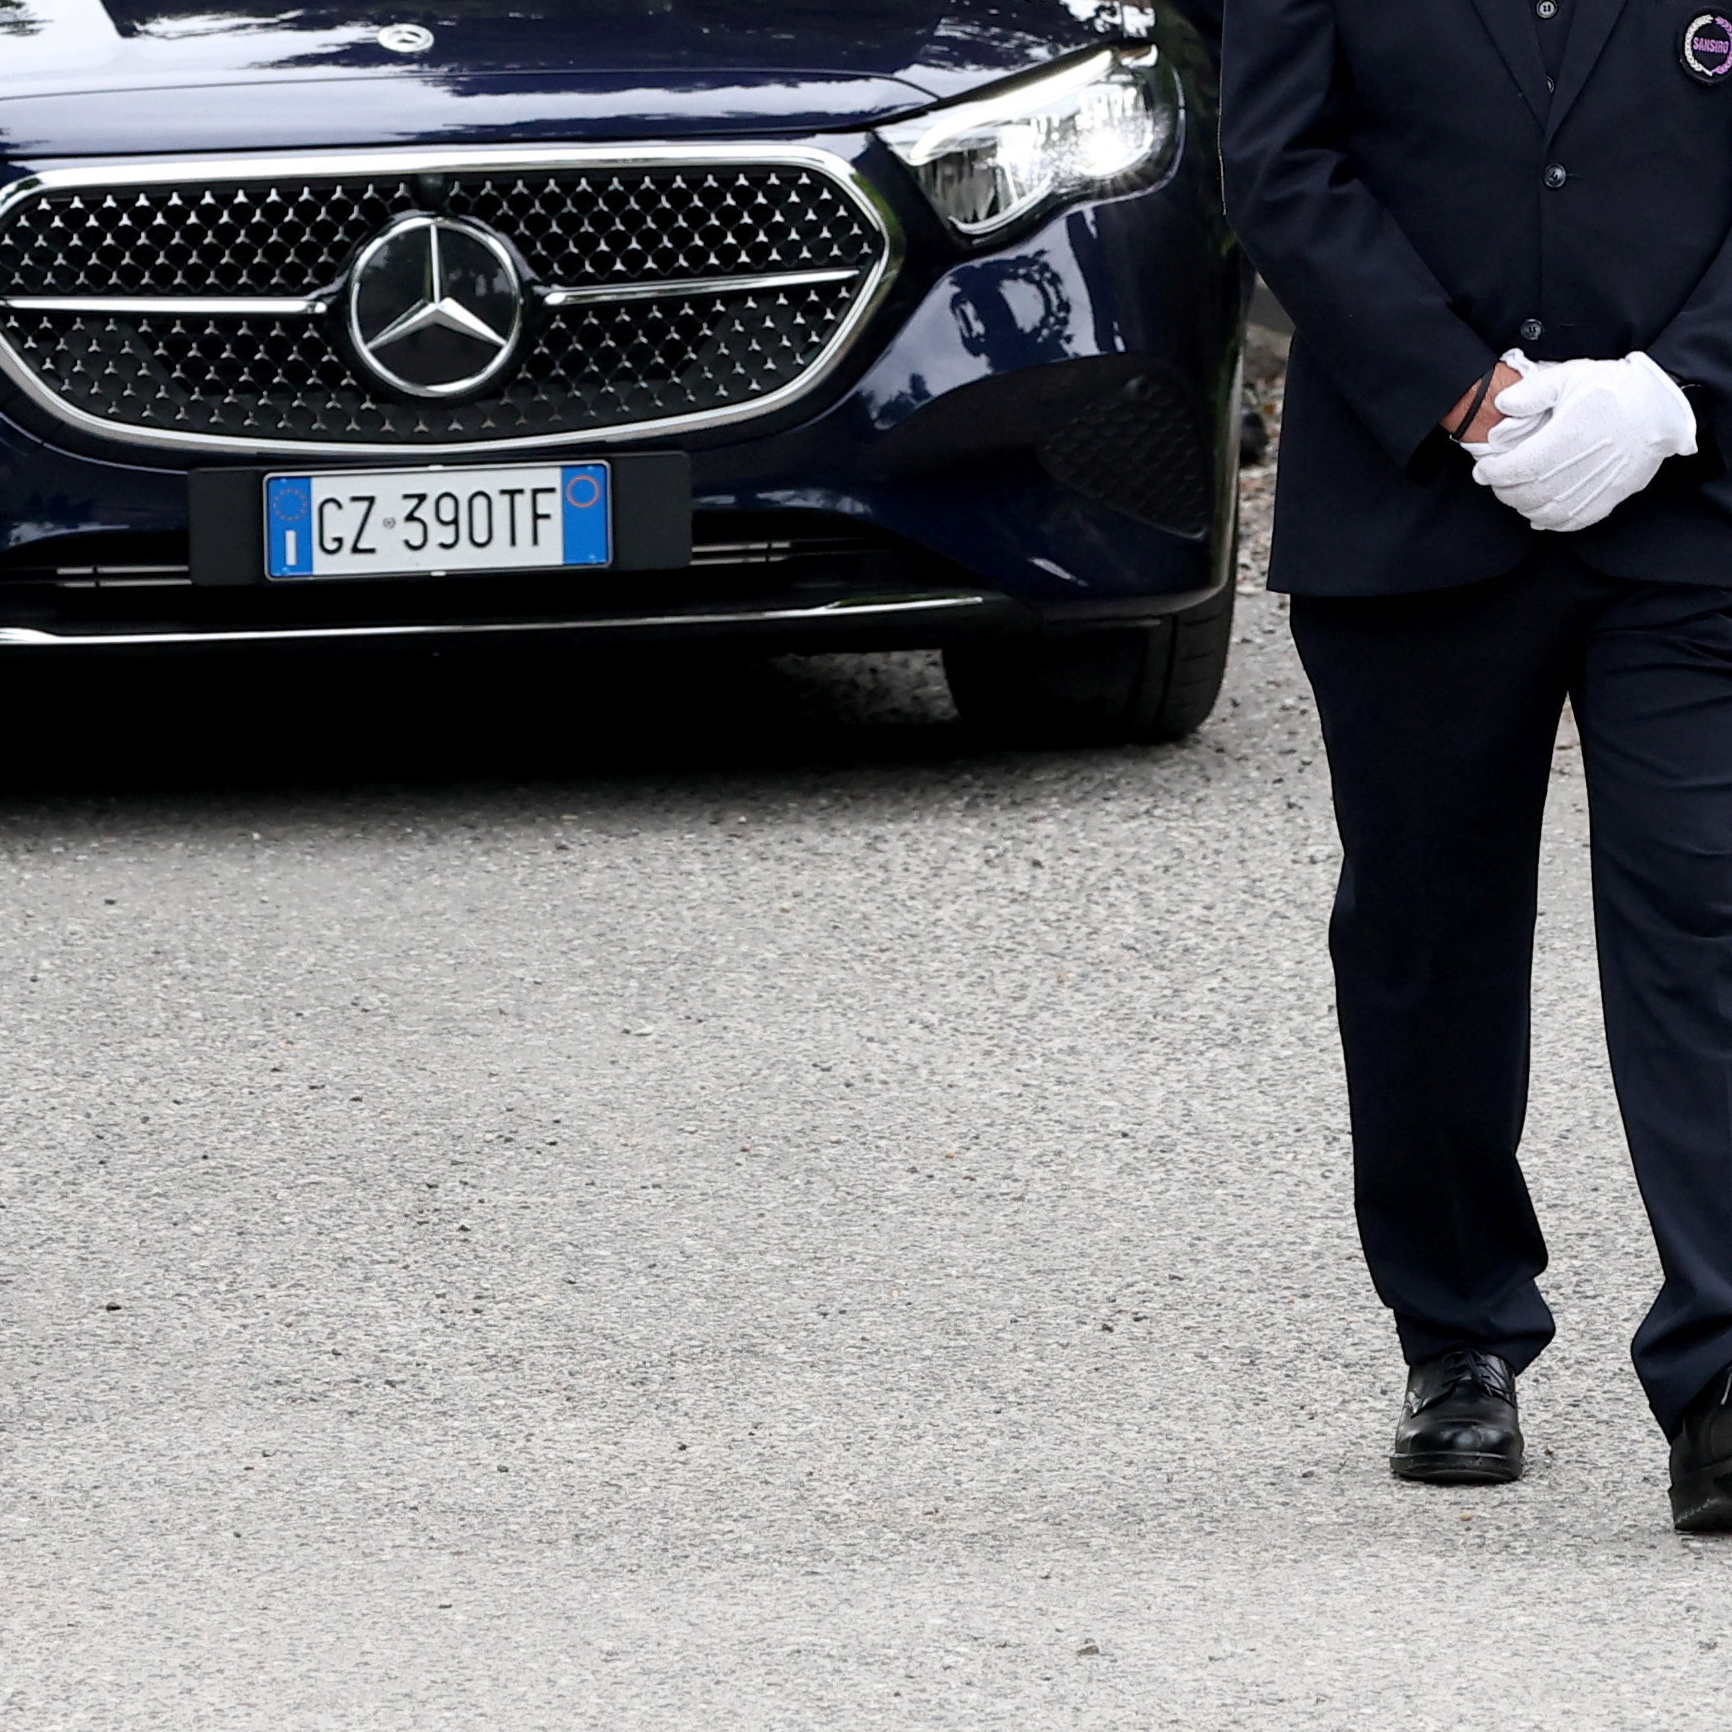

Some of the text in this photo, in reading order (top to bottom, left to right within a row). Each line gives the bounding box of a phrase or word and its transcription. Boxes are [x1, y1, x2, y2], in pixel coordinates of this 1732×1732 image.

[1692, 36, 1730, 55] SANSIRO
[317, 486, 557, 556] GZ 390TF
